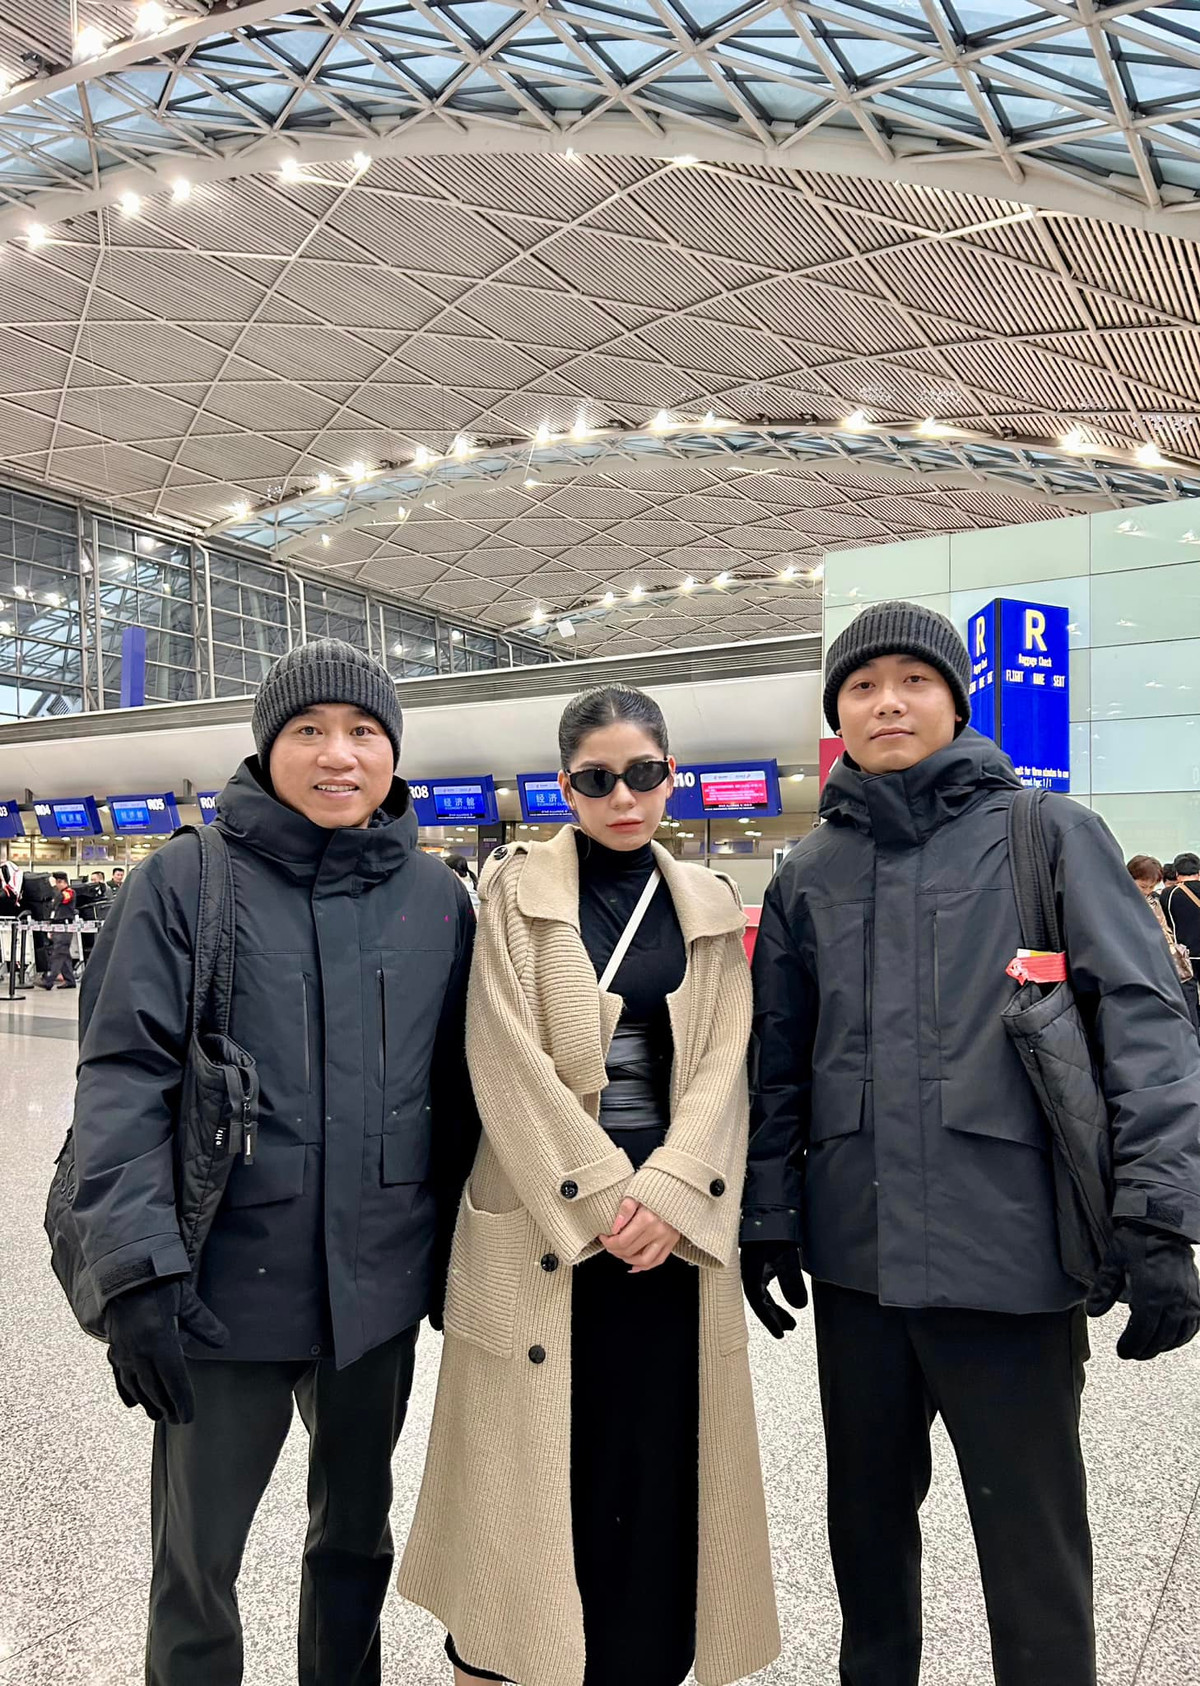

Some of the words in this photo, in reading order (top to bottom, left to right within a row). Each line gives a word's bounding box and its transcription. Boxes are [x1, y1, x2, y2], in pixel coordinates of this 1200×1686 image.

[976, 616, 986, 657] R
[1025, 608, 1048, 651] R
[146, 798, 165, 811] R05
